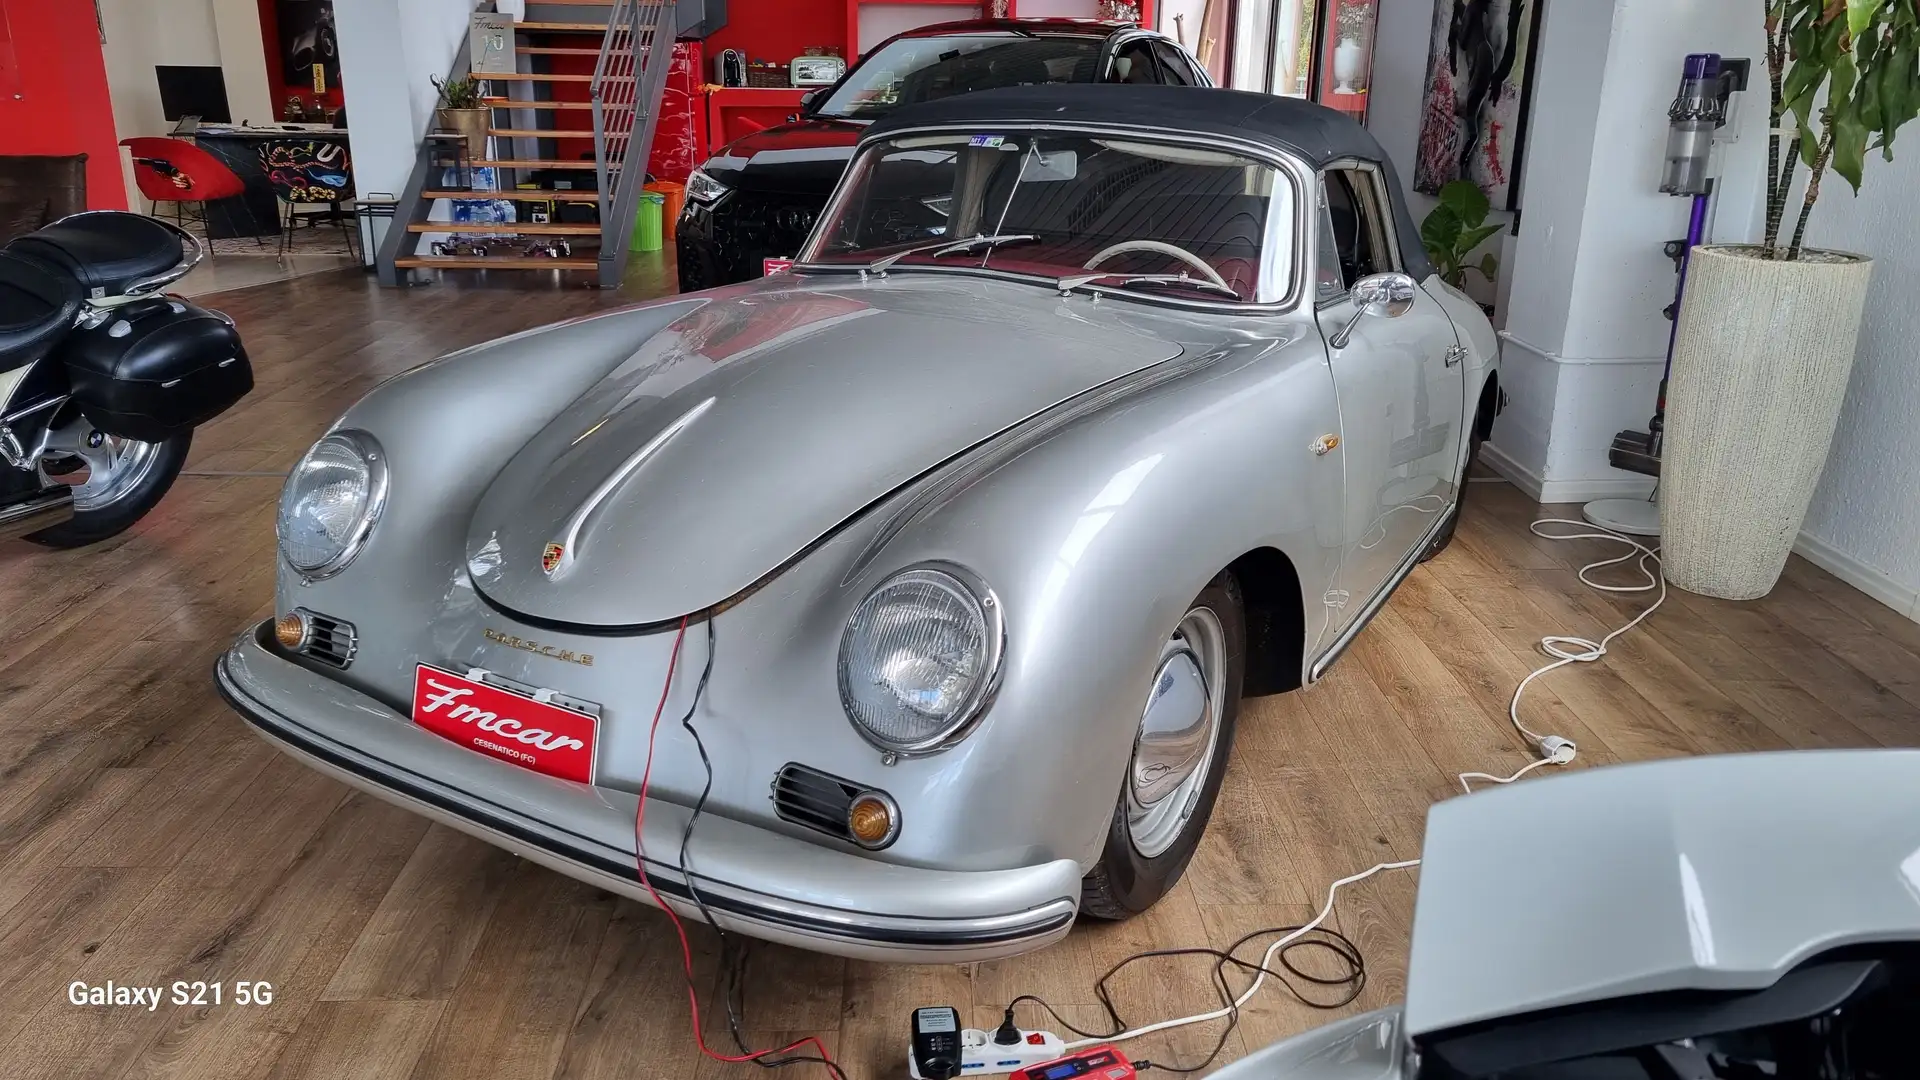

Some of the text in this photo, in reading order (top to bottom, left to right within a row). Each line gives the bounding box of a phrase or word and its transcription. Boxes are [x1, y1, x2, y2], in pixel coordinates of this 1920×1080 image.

[483, 628, 595, 667] PORSCHE
[422, 678, 584, 751] Fmcar
[473, 737, 536, 765] CESENATICO (FC)
